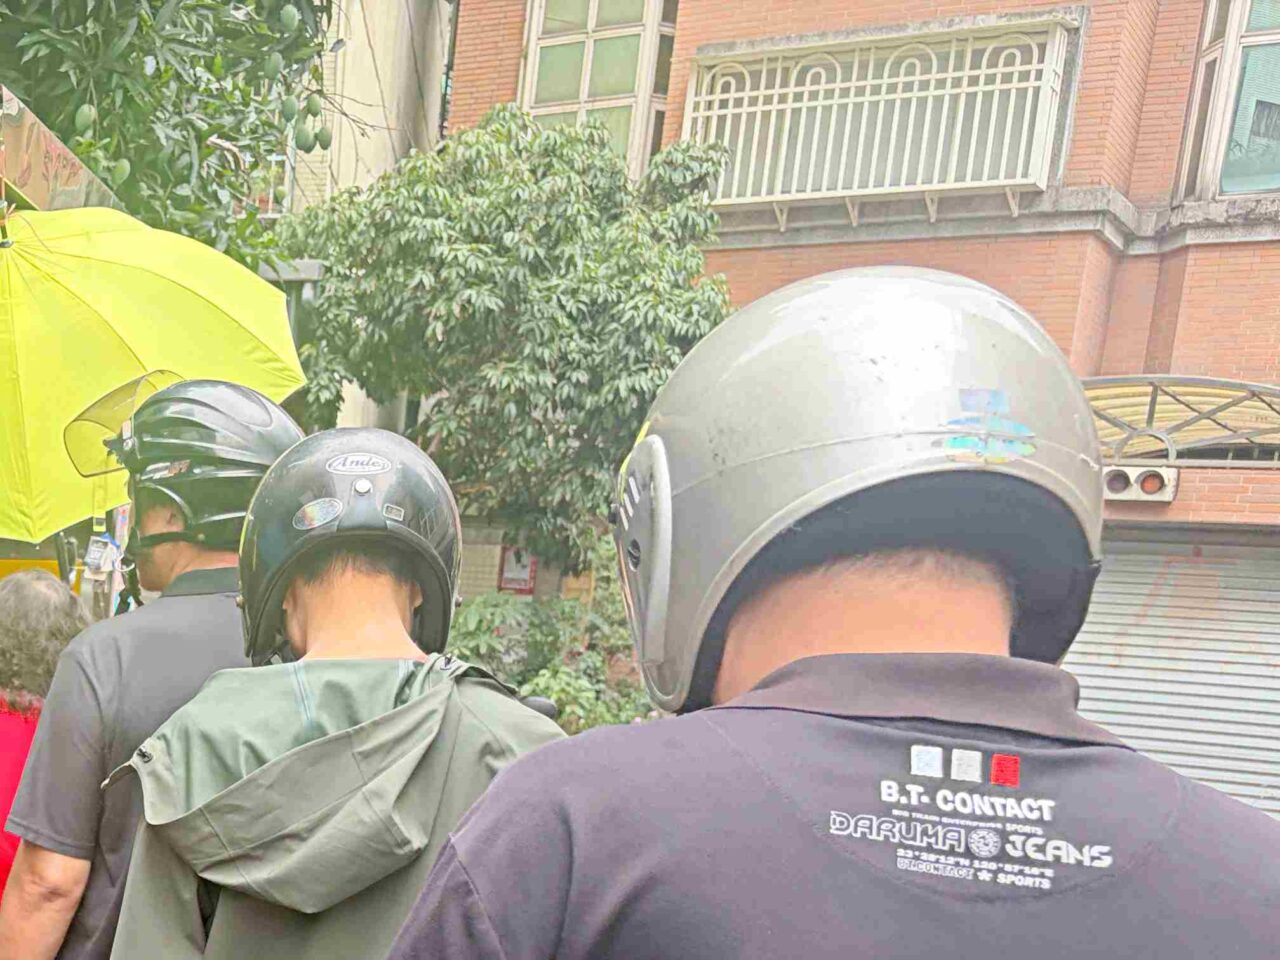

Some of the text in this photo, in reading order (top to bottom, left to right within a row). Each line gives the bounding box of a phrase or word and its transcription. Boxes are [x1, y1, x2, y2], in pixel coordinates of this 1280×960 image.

[936, 789, 1056, 822] CONTACT
[830, 810, 1114, 869] DARUMA JEANS
[1005, 823, 1044, 836] SPORTS
[996, 873, 1051, 890] SPORTS
